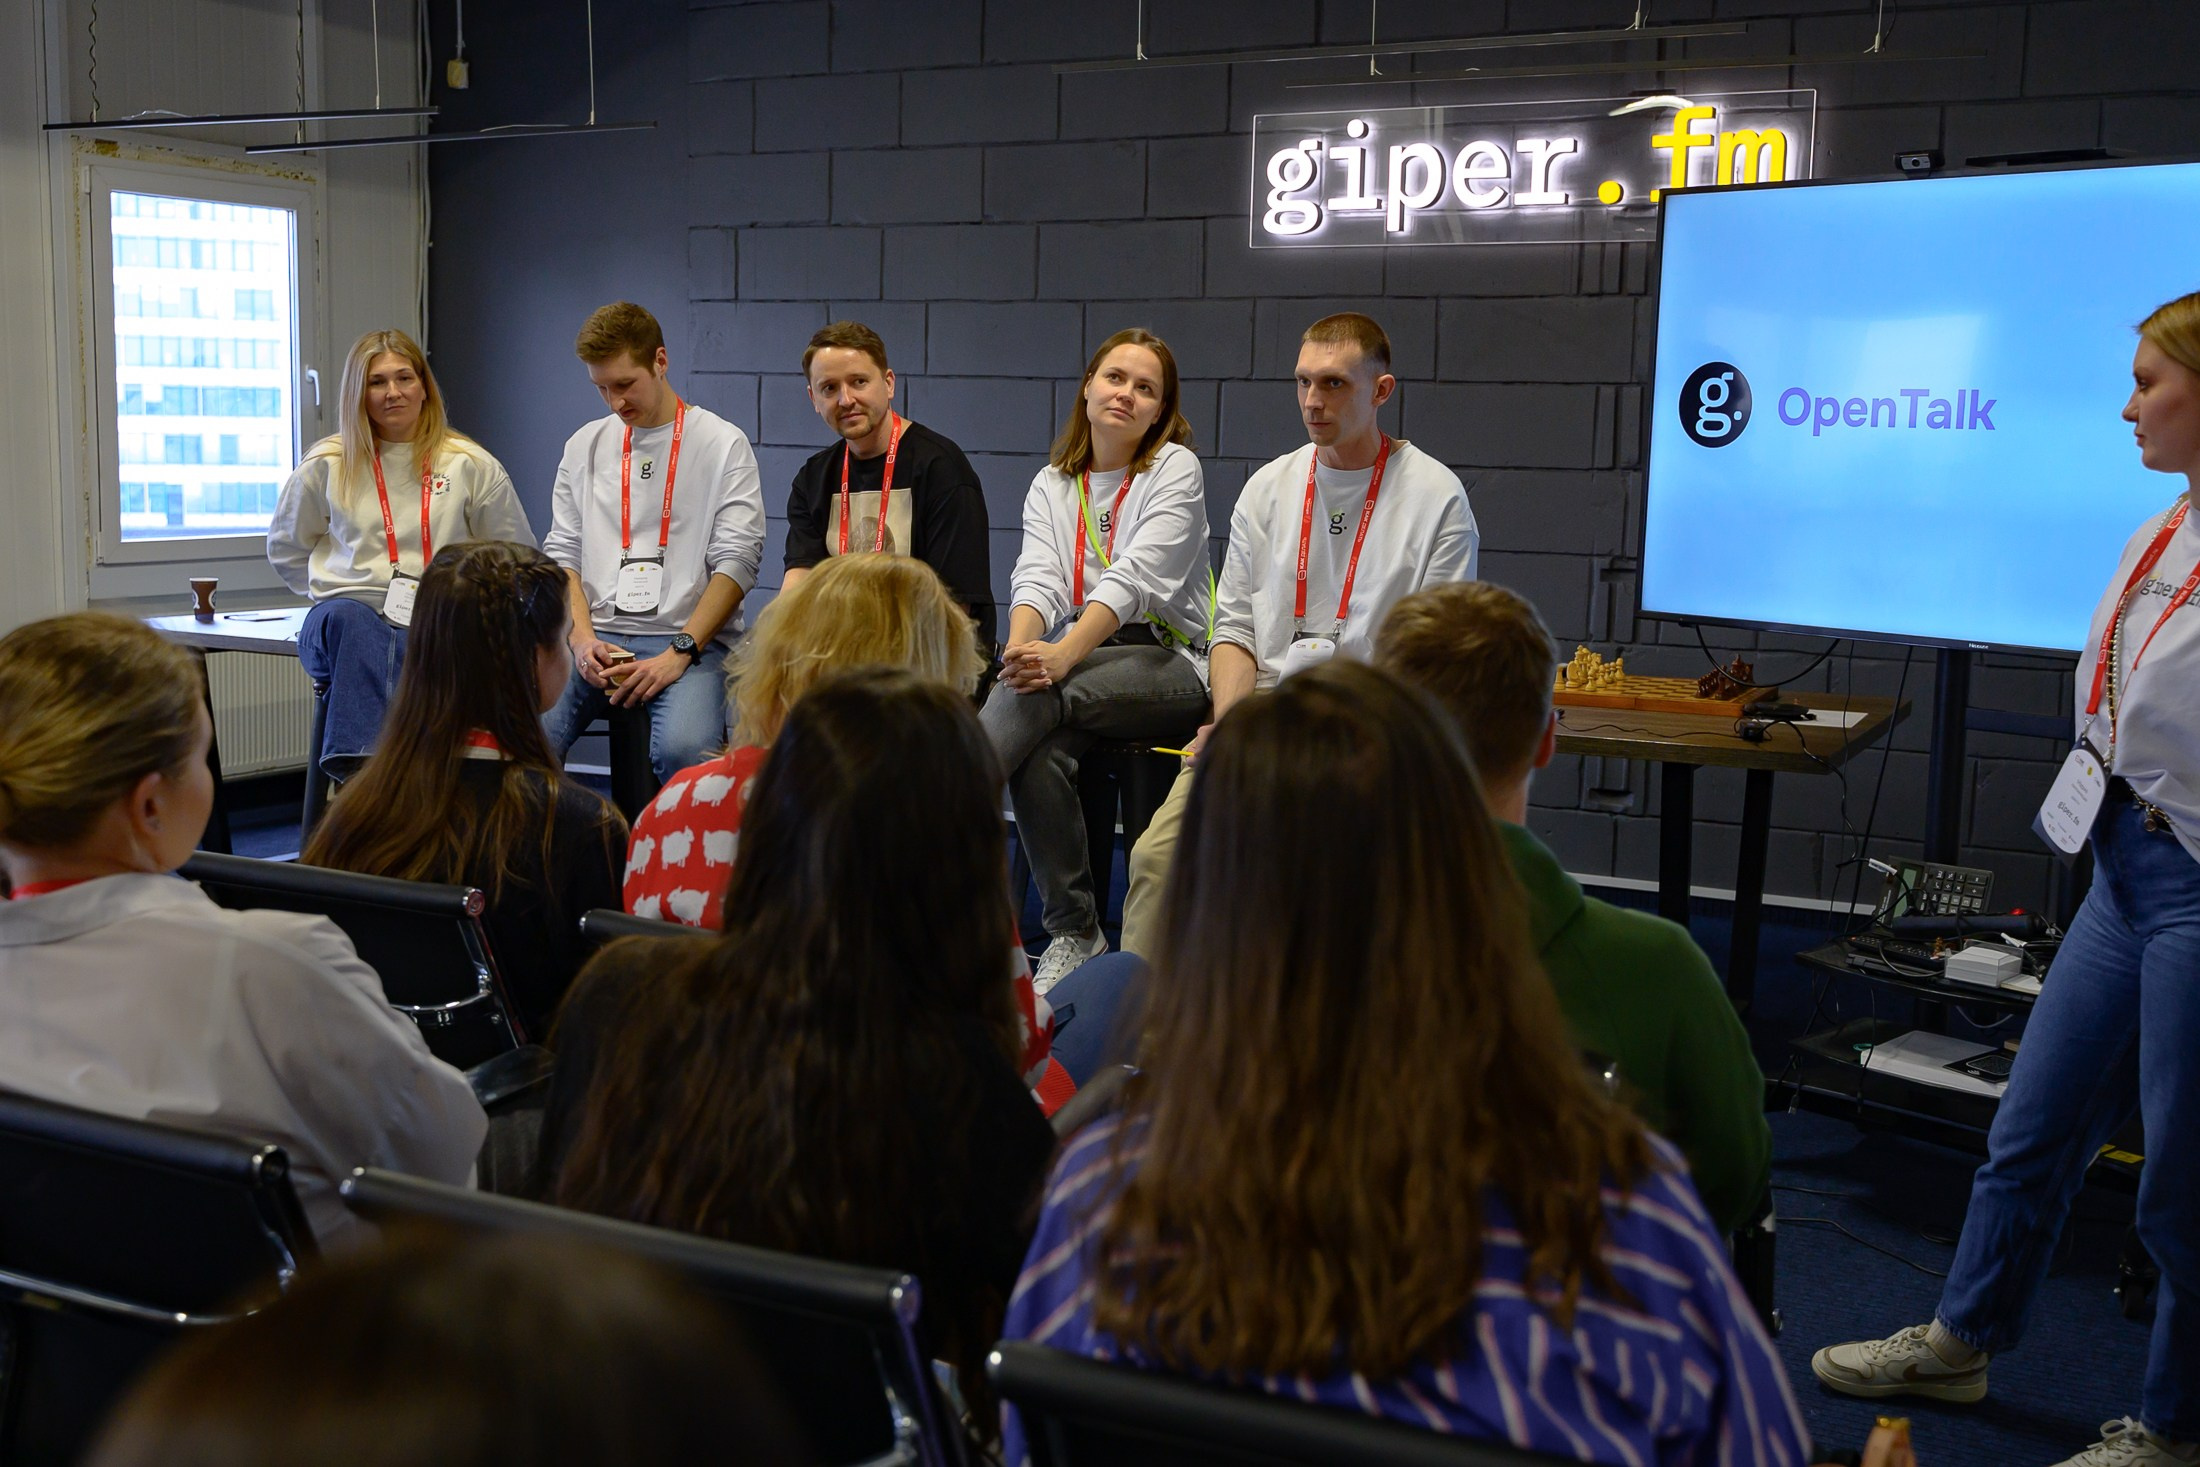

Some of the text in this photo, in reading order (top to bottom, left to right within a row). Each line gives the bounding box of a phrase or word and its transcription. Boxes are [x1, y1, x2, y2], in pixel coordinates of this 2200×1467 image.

[1694, 371, 1743, 438] g.
[1778, 386, 1997, 437] OpenTalk
[1328, 512, 1348, 535] g.
[1358, 522, 1367, 543] ДЕЛАТЬ
[1300, 536, 1308, 557] ДЕЛАТЬ
[2174, 589, 2188, 606] КАК
[2102, 631, 2111, 648] КАК
